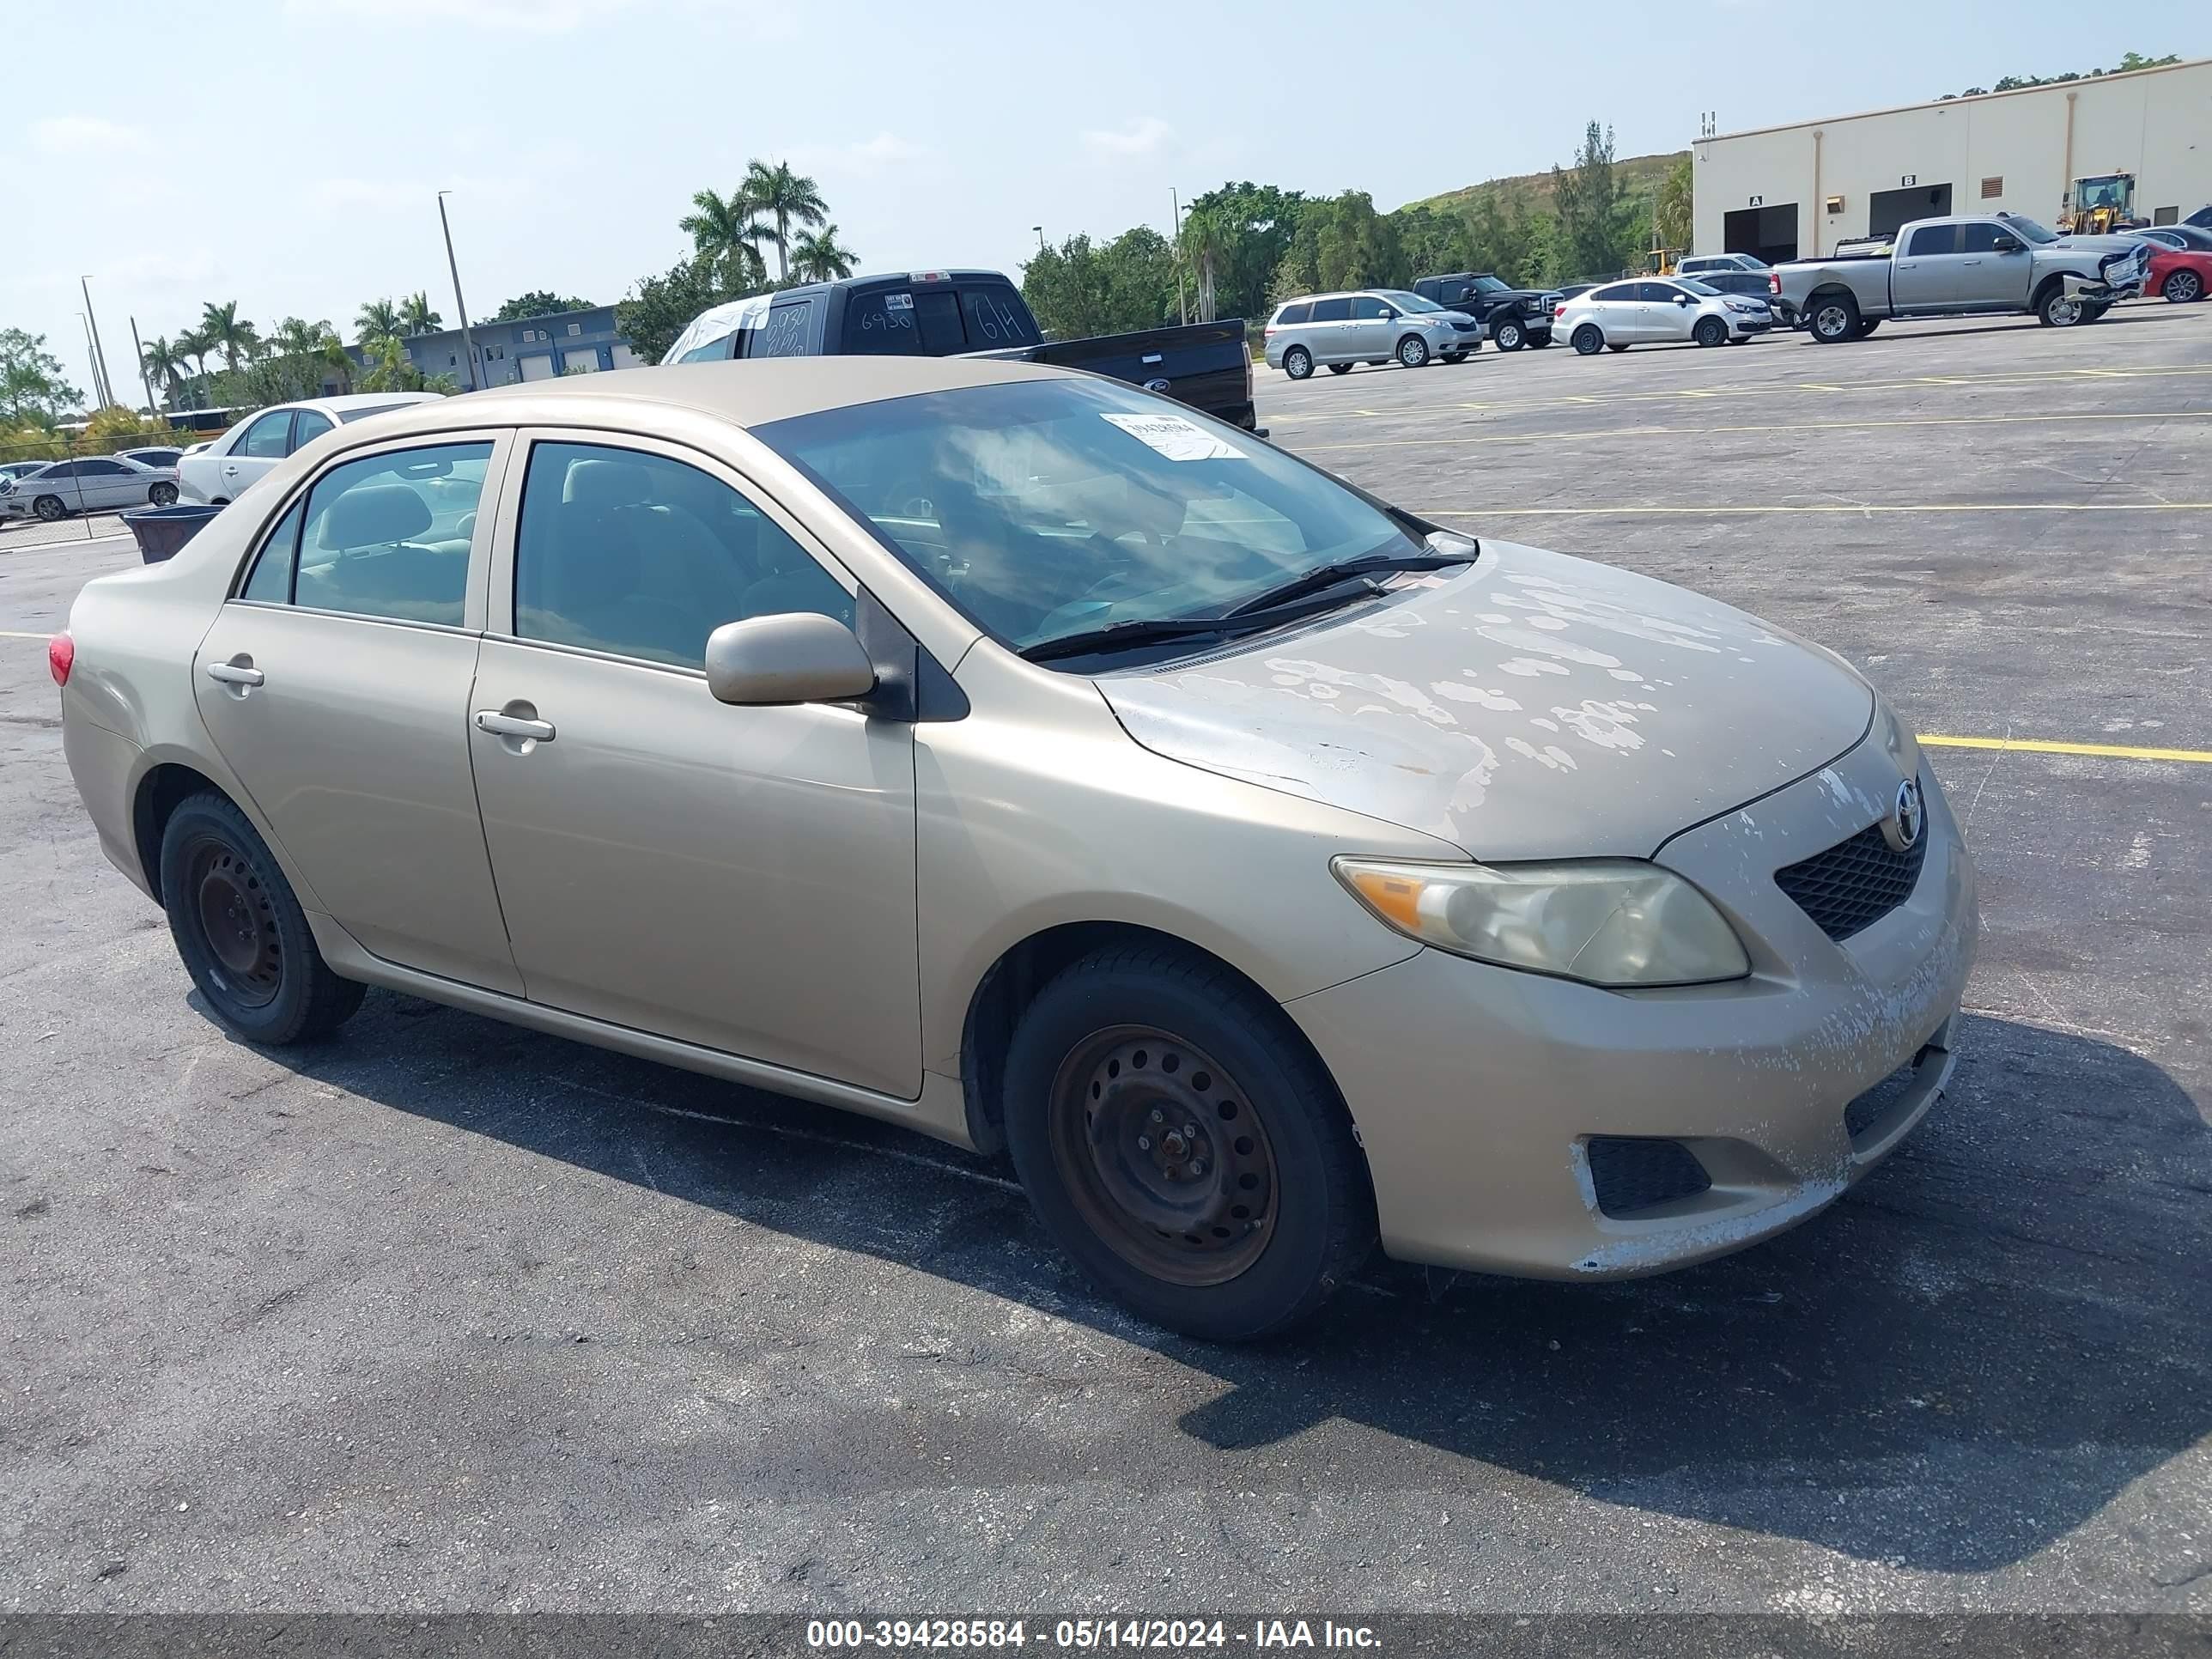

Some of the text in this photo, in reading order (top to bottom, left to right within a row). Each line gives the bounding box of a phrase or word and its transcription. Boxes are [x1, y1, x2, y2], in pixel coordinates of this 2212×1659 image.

[1904, 176, 1914, 185] B
[1751, 197, 1760, 206] A
[766, 306, 807, 342] 6930
[861, 311, 911, 331] 6930
